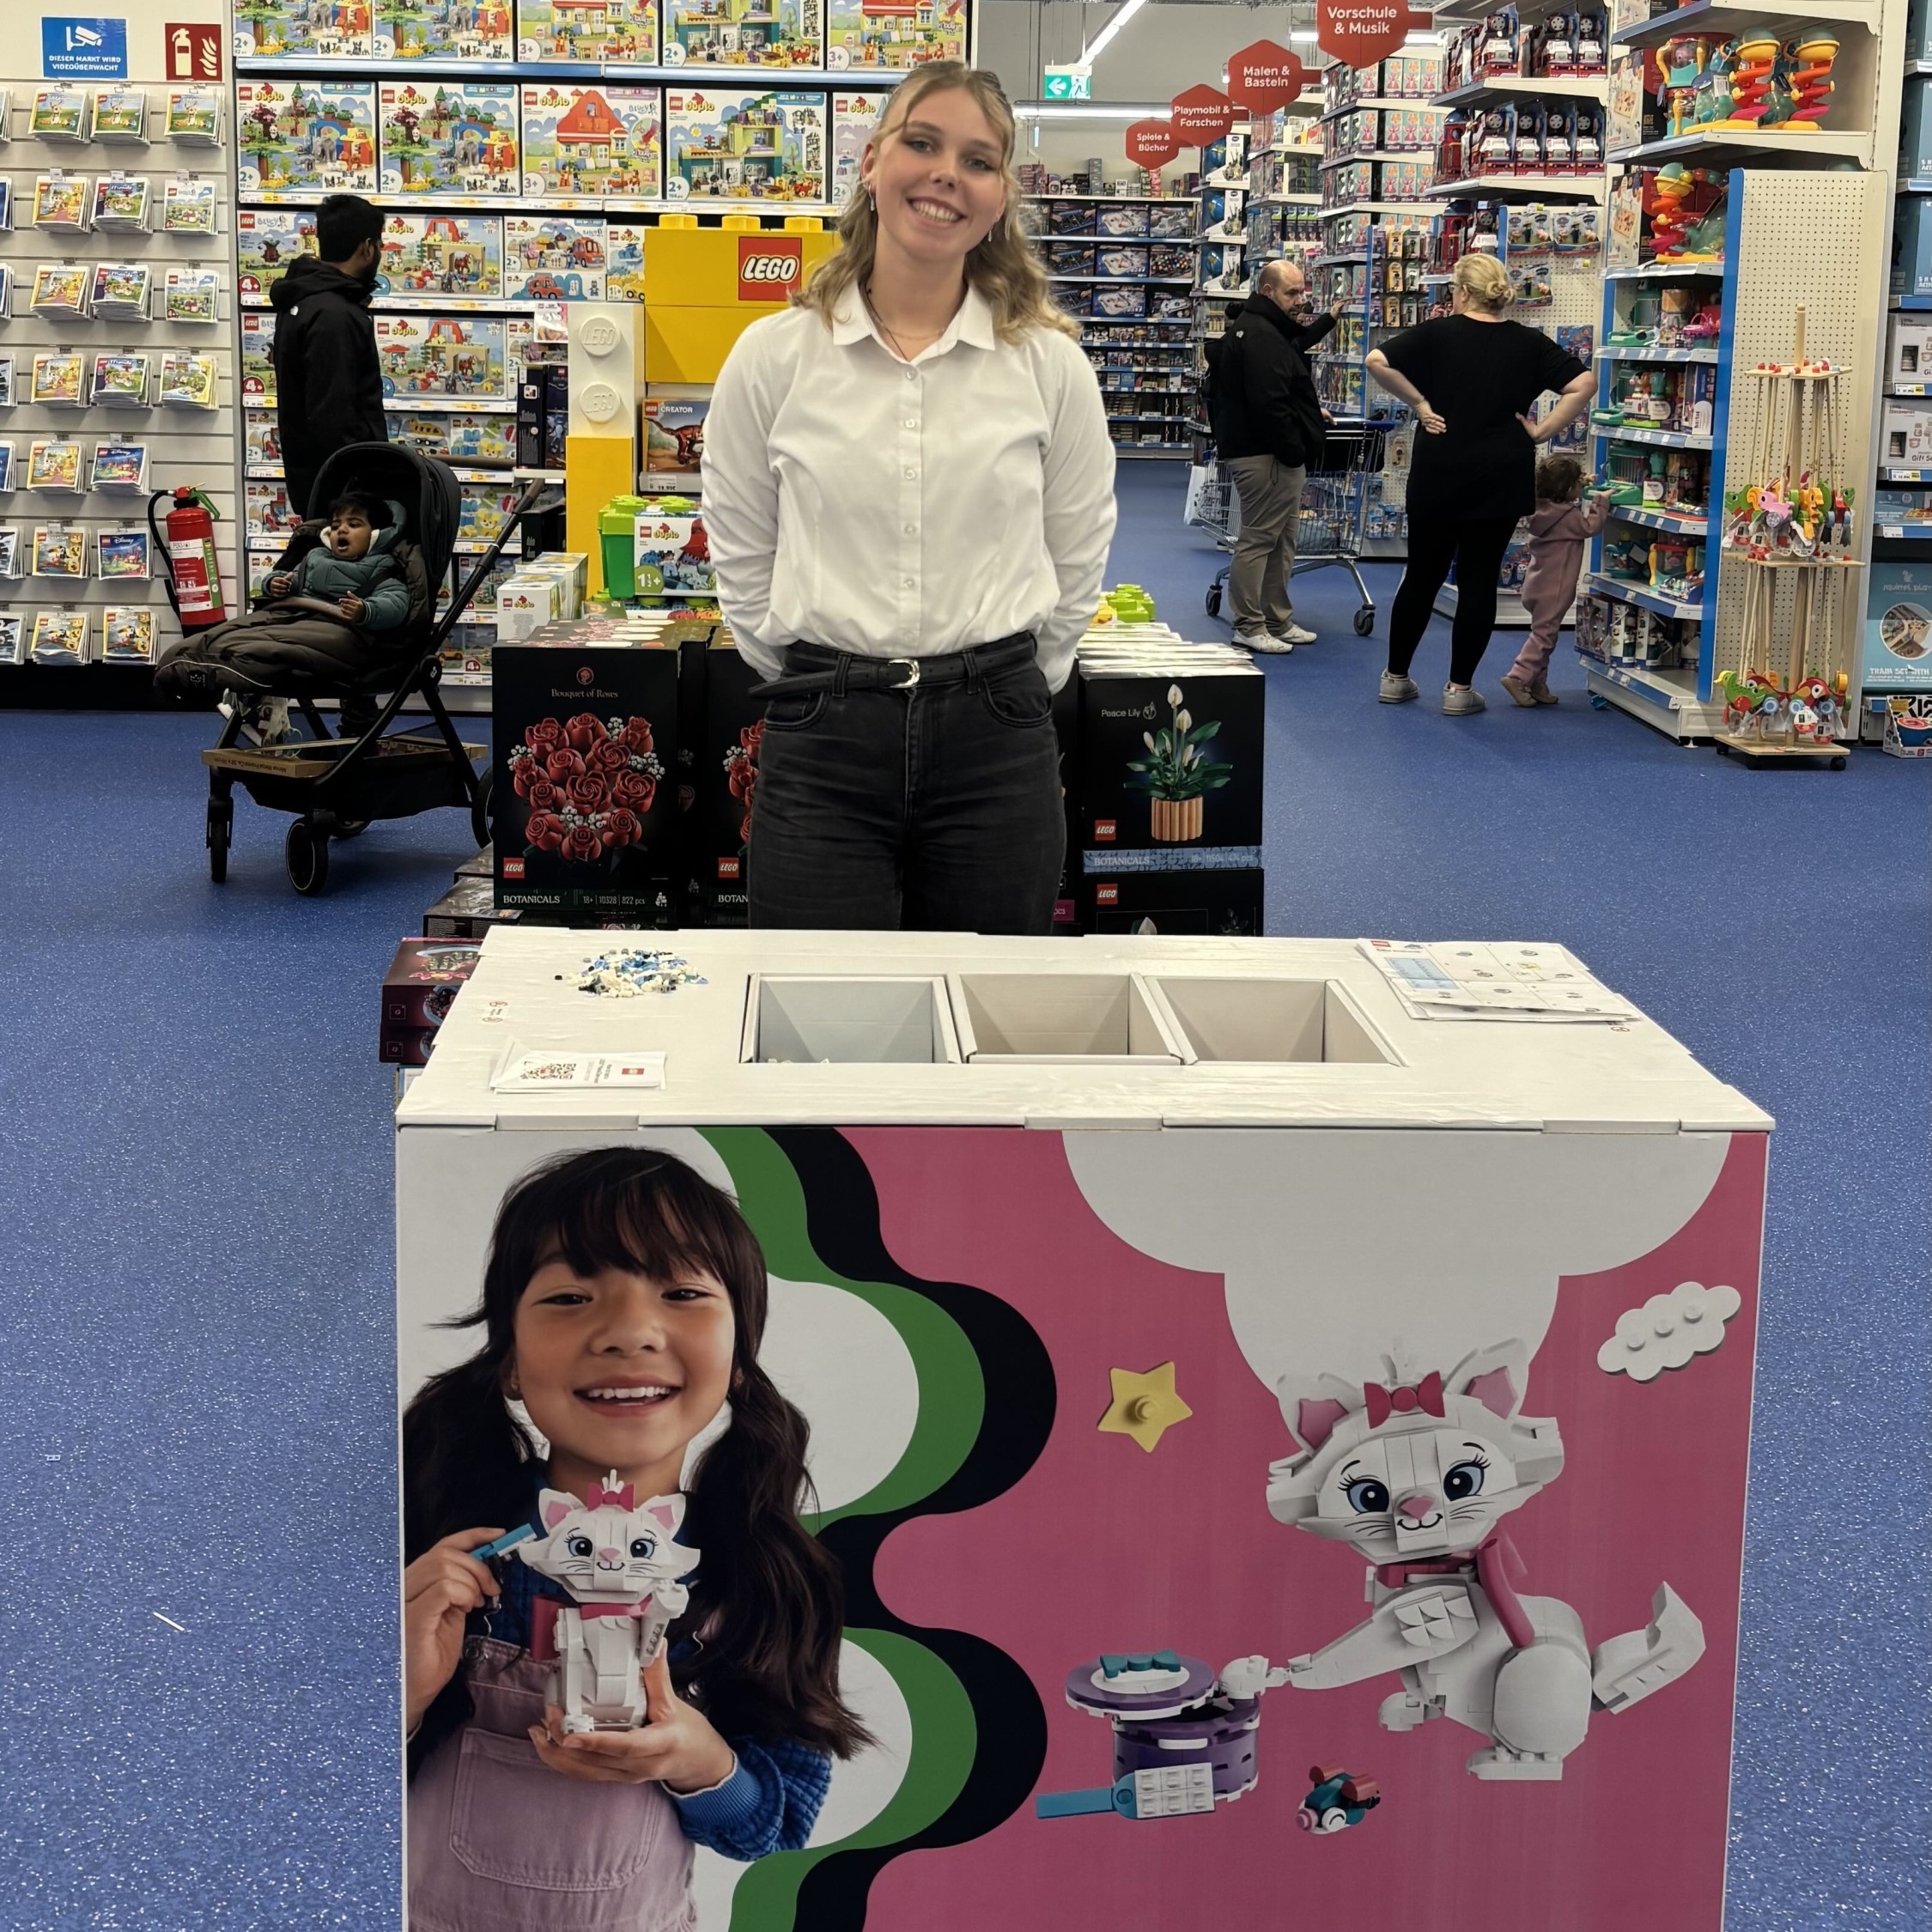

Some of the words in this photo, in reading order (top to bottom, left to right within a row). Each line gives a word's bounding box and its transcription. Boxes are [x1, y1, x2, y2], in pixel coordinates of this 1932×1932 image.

[1327, 6, 1397, 19] Vorschule
[1334, 23, 1345, 34] &
[1349, 22, 1390, 34] Musik
[234, 38, 249, 48] 2+
[374, 37, 388, 52] 2+
[519, 43, 533, 54] 3+
[665, 47, 678, 59] 2+
[829, 50, 843, 62] 3+
[52, 62, 118, 71] VIDEOÜBERWACHT
[1242, 66, 1279, 76] Malen
[1281, 65, 1291, 76] &
[1244, 76, 1288, 88] Basteln
[254, 91, 284, 102] duplo
[397, 94, 427, 106] duplo
[539, 94, 569, 107] duplo
[684, 100, 714, 112] duplo
[849, 104, 876, 114] duplo
[1174, 105, 1221, 117] Playmobil
[1222, 105, 1230, 114] &
[1180, 118, 1224, 127] Forschen
[1136, 132, 1163, 142] Spiele
[1138, 143, 1169, 153] Bücher
[240, 172, 253, 182] 2+
[381, 174, 396, 185] 2+
[524, 177, 538, 189] 3+
[669, 181, 682, 192] 2+
[833, 186, 846, 197] 2+
[387, 223, 414, 234] duplo
[741, 254, 799, 283] LEGO
[241, 278, 259, 291] 4+
[391, 325, 418, 337] duplo
[583, 327, 616, 346] LEGO
[246, 380, 263, 392] 4+
[653, 529, 680, 540] duplo
[113, 536, 135, 545] Disney
[550, 689, 585, 700] Bouquet
[586, 689, 595, 698] of
[596, 689, 619, 699] Roses
[1101, 709, 1127, 718] Peace
[1127, 708, 1140, 719] Lily
[1097, 825, 1115, 834] LEGO
[1094, 856, 1151, 866] BOTANICALS
[506, 863, 524, 872] LEGO
[720, 863, 738, 872] LEGO
[718, 894, 748, 902] BOTAN
[1098, 890, 1116, 898] LEGO
[503, 895, 561, 904] BOTANICALS
[583, 896, 594, 904] 18+
[598, 896, 617, 904] 10328
[622, 896, 634, 904] 822
[635, 897, 646, 906] pcs
